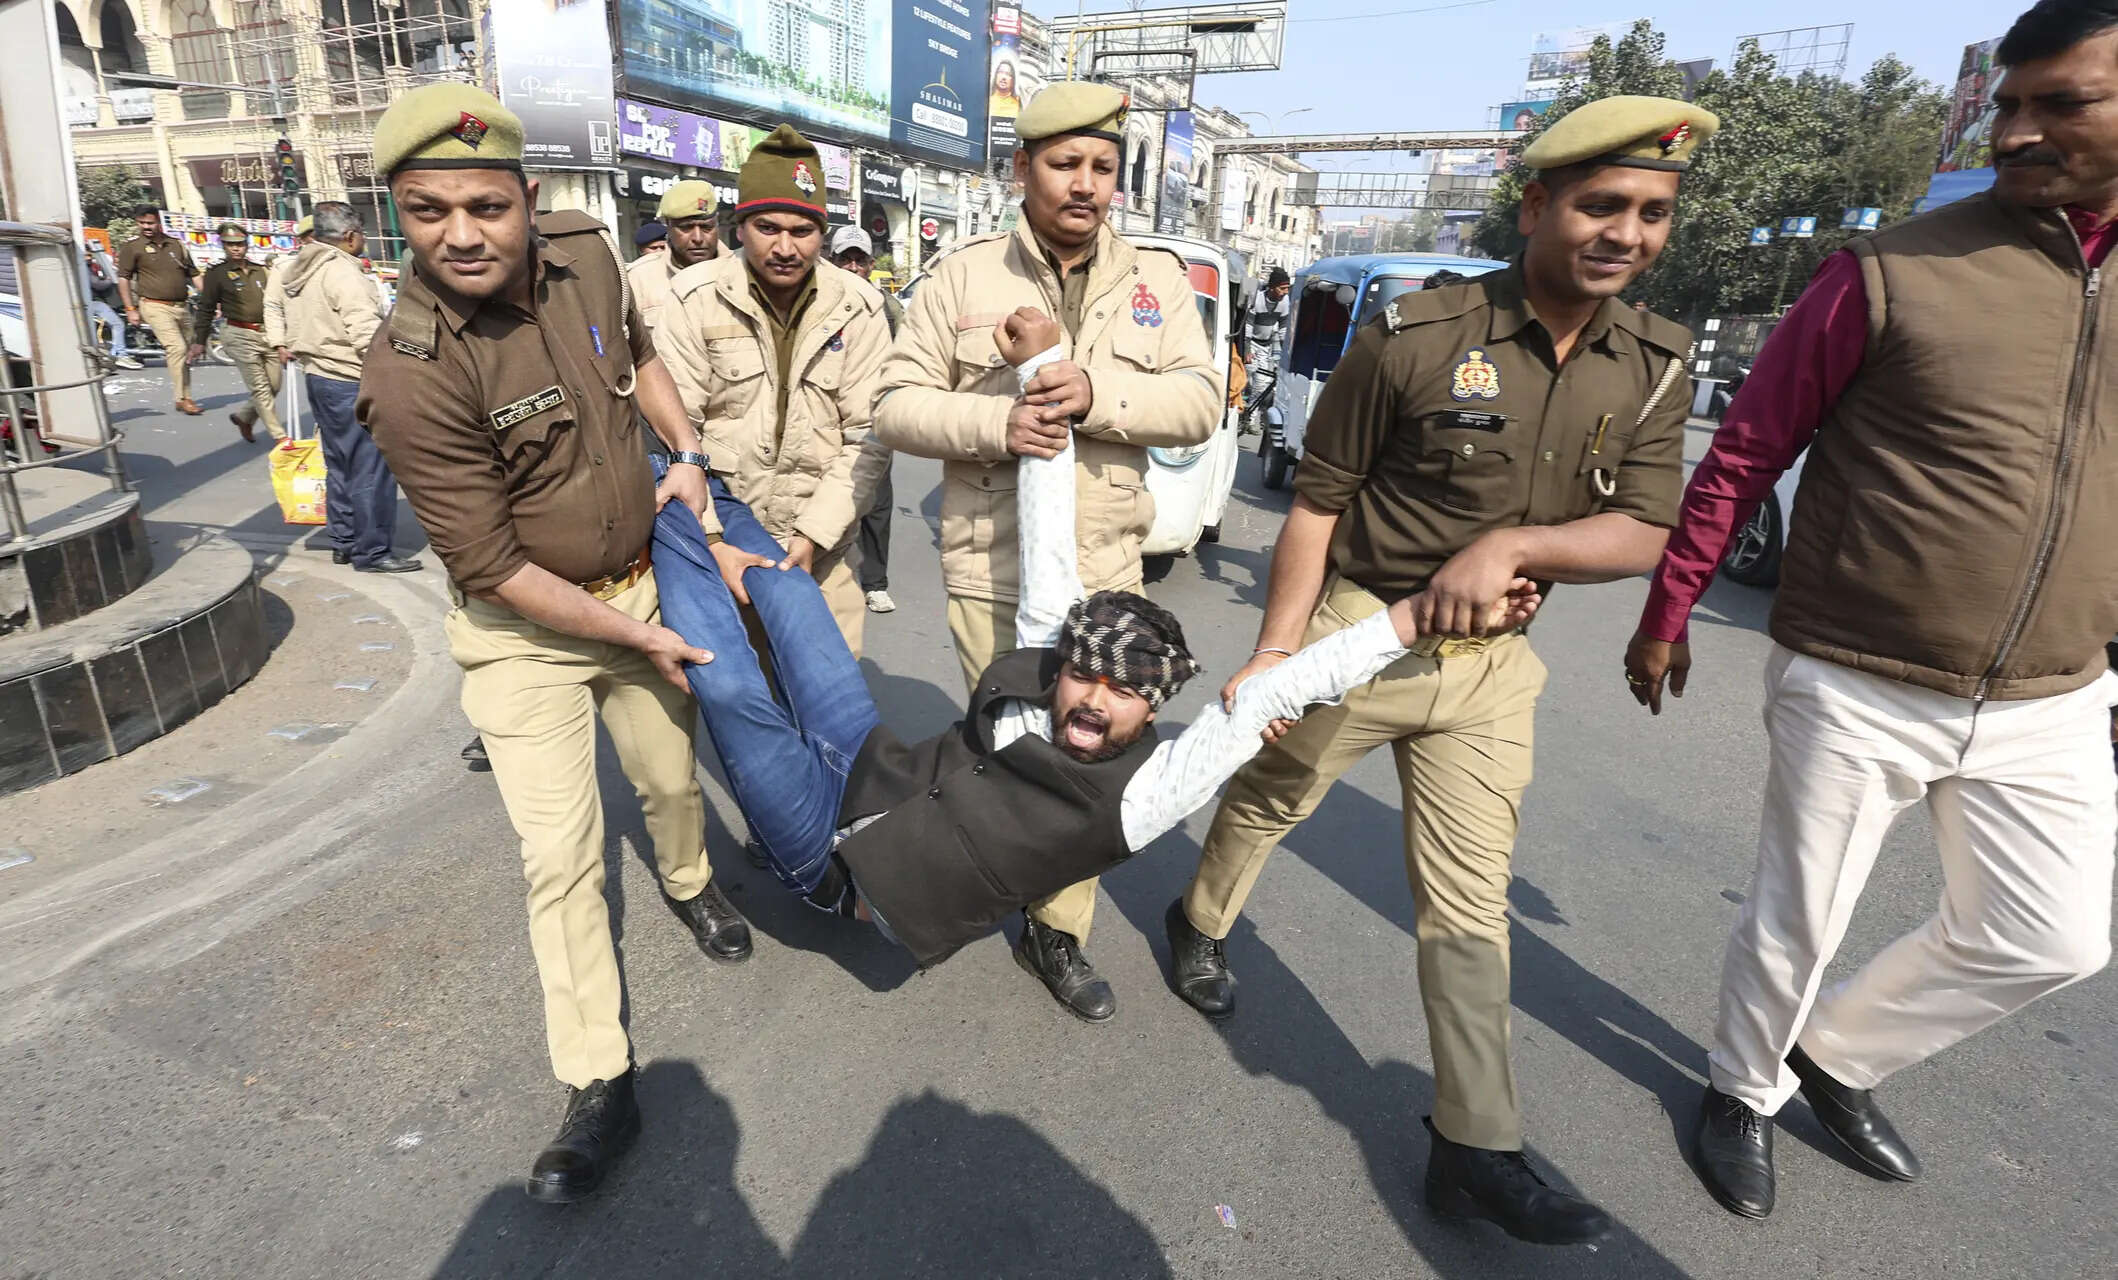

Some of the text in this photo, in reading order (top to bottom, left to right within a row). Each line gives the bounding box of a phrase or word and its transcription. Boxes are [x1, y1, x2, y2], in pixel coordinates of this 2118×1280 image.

[920, 90, 963, 112] SHALIMAR
[642, 123, 671, 141] POP
[622, 133, 677, 158] REPEAT
